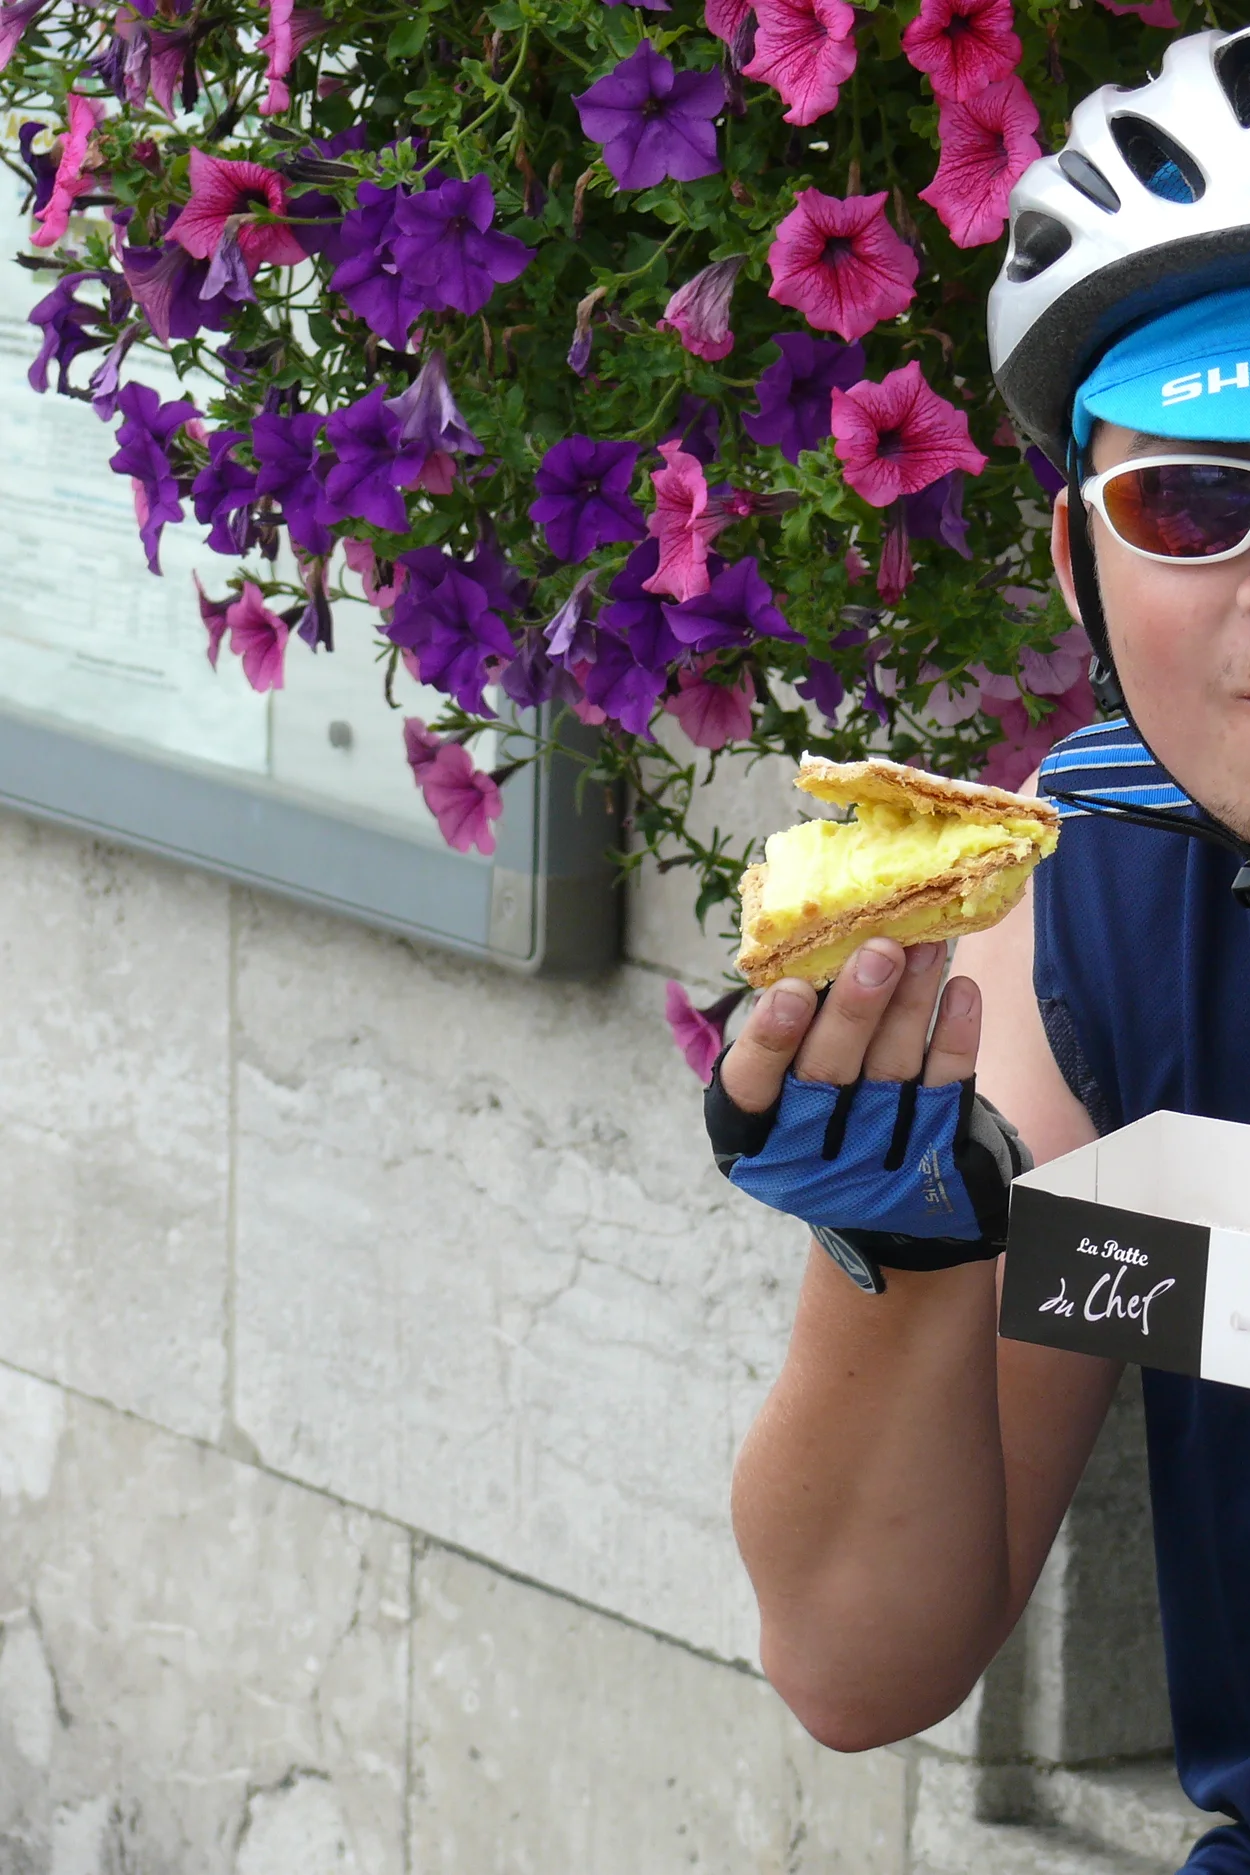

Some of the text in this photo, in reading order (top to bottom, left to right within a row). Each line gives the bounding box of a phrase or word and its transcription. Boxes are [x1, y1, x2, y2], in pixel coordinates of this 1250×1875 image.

[1076, 1237, 1149, 1267] La Patte
[1038, 1264, 1176, 1336] du Chef
